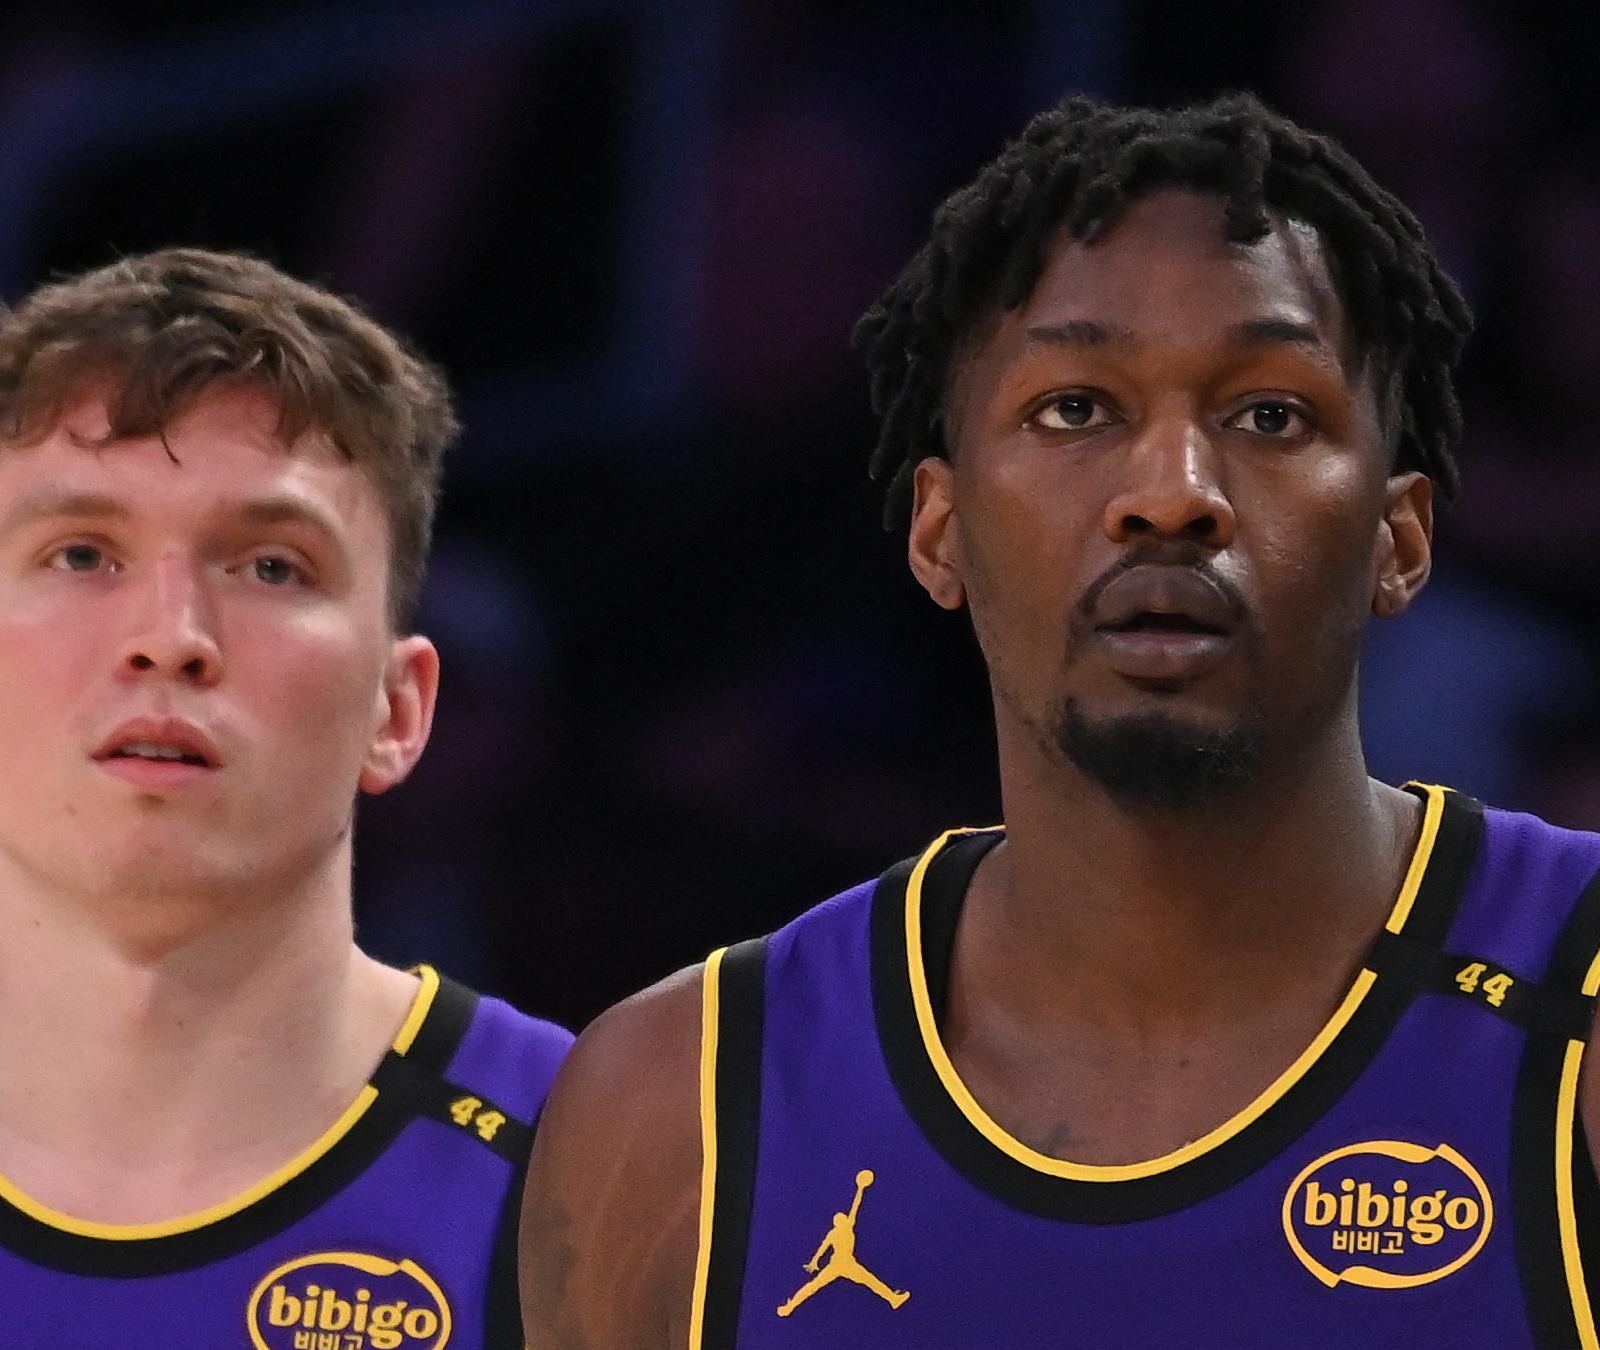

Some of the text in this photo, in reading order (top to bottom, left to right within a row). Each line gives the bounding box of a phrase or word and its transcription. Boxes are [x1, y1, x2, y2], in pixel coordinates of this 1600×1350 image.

[1455, 962, 1514, 1008] 44
[450, 1096, 506, 1142] 44
[1304, 1178, 1480, 1245] bibigo
[1332, 1230, 1405, 1255] 비비고
[268, 1284, 438, 1350] bibigo
